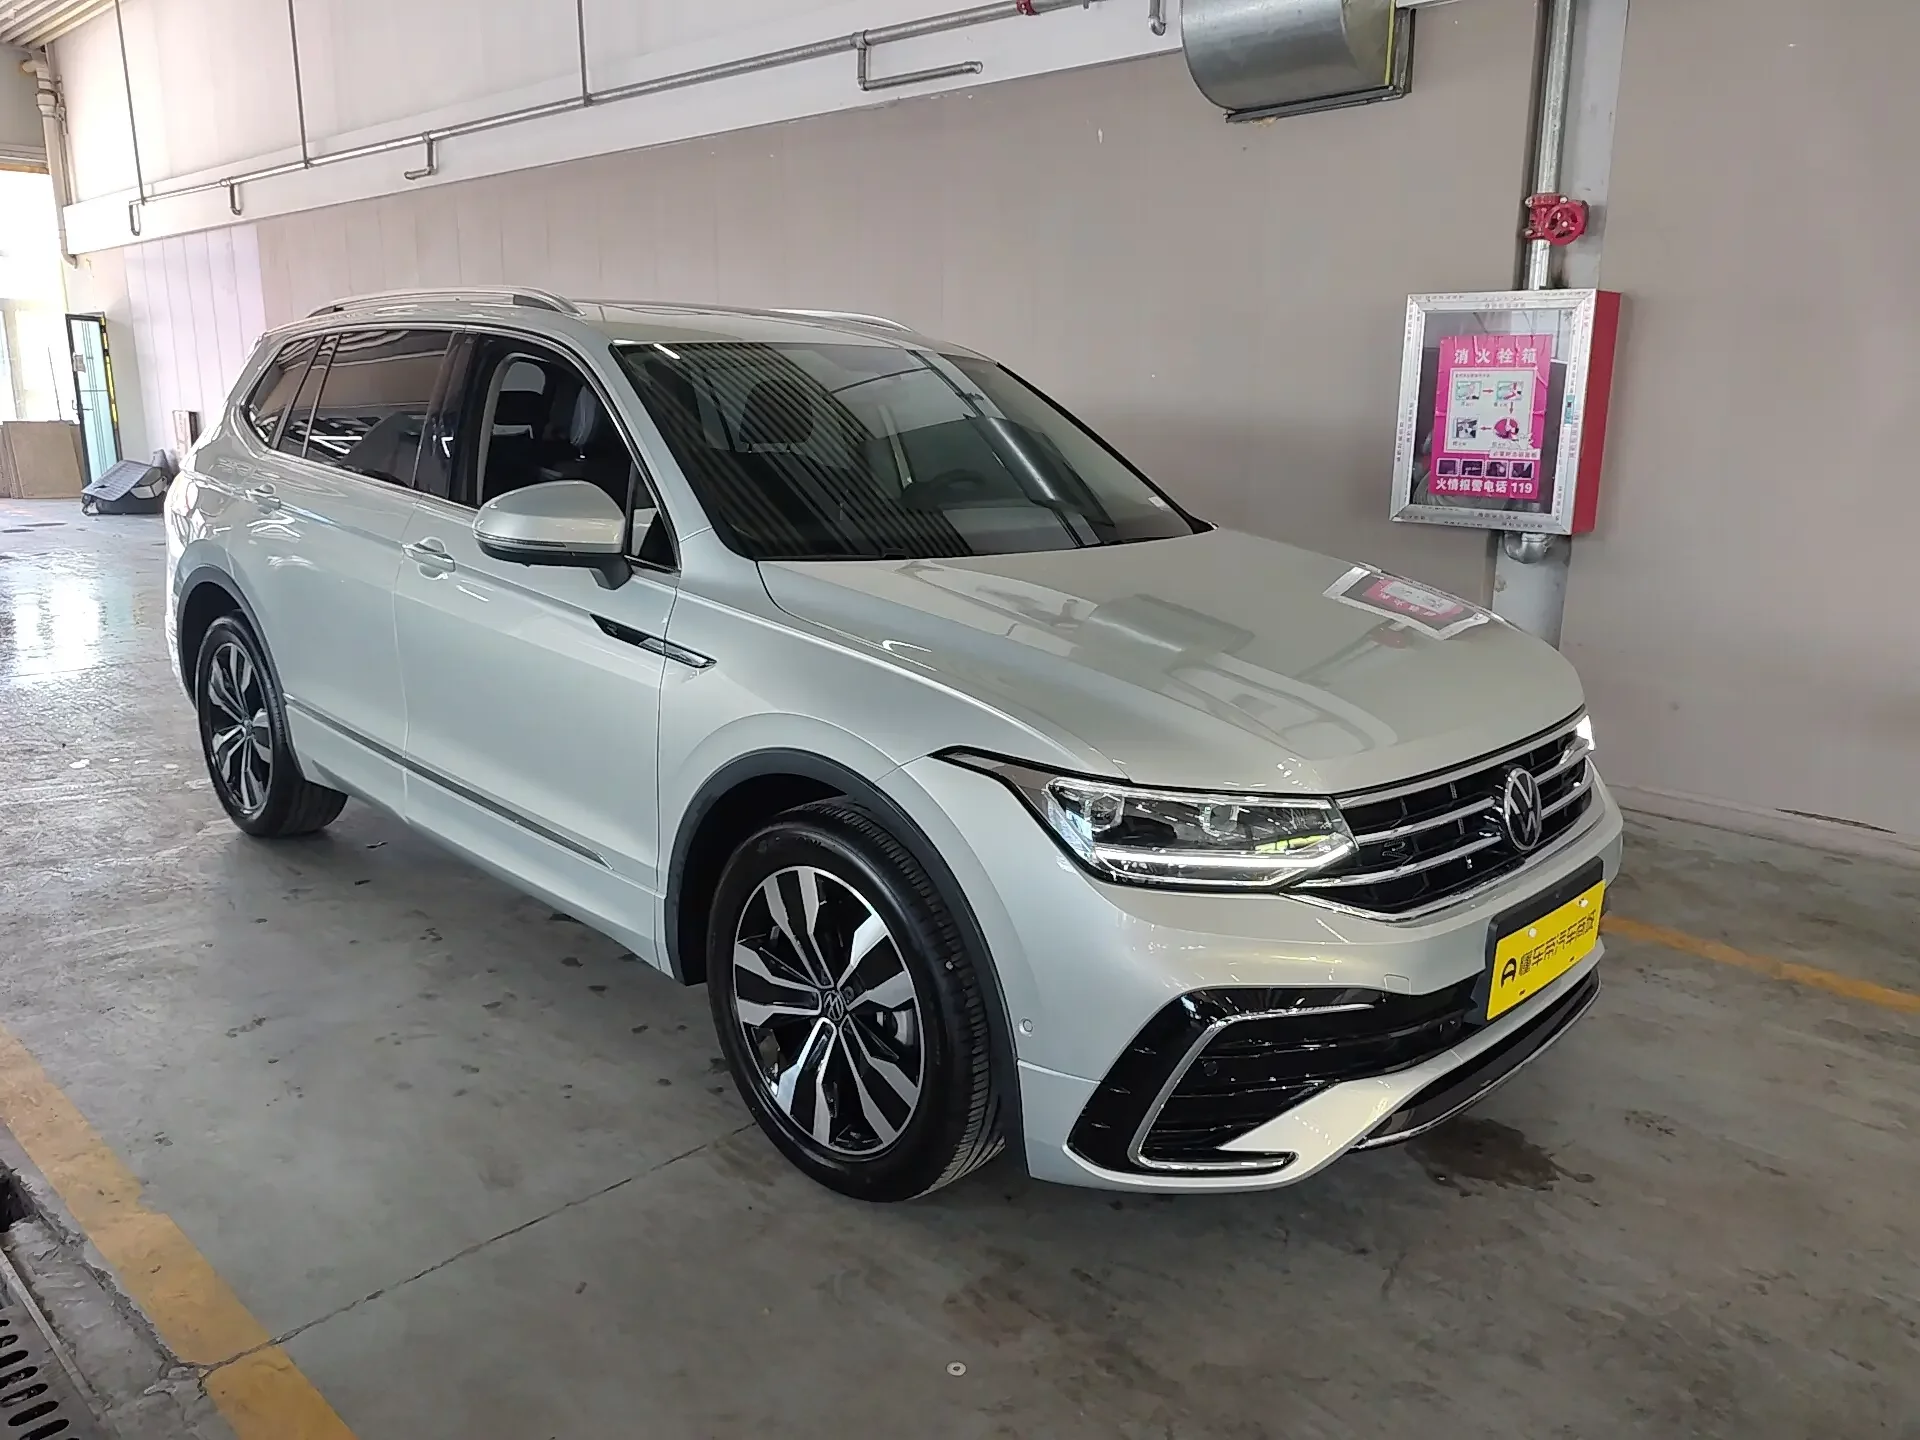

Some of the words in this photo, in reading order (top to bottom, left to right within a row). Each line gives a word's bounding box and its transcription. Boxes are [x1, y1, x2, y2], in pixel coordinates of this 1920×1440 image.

[1454, 348, 1538, 365] 消火栓箱
[1435, 478, 1508, 494] 火情报警电话
[1511, 480, 1533, 494] 119
